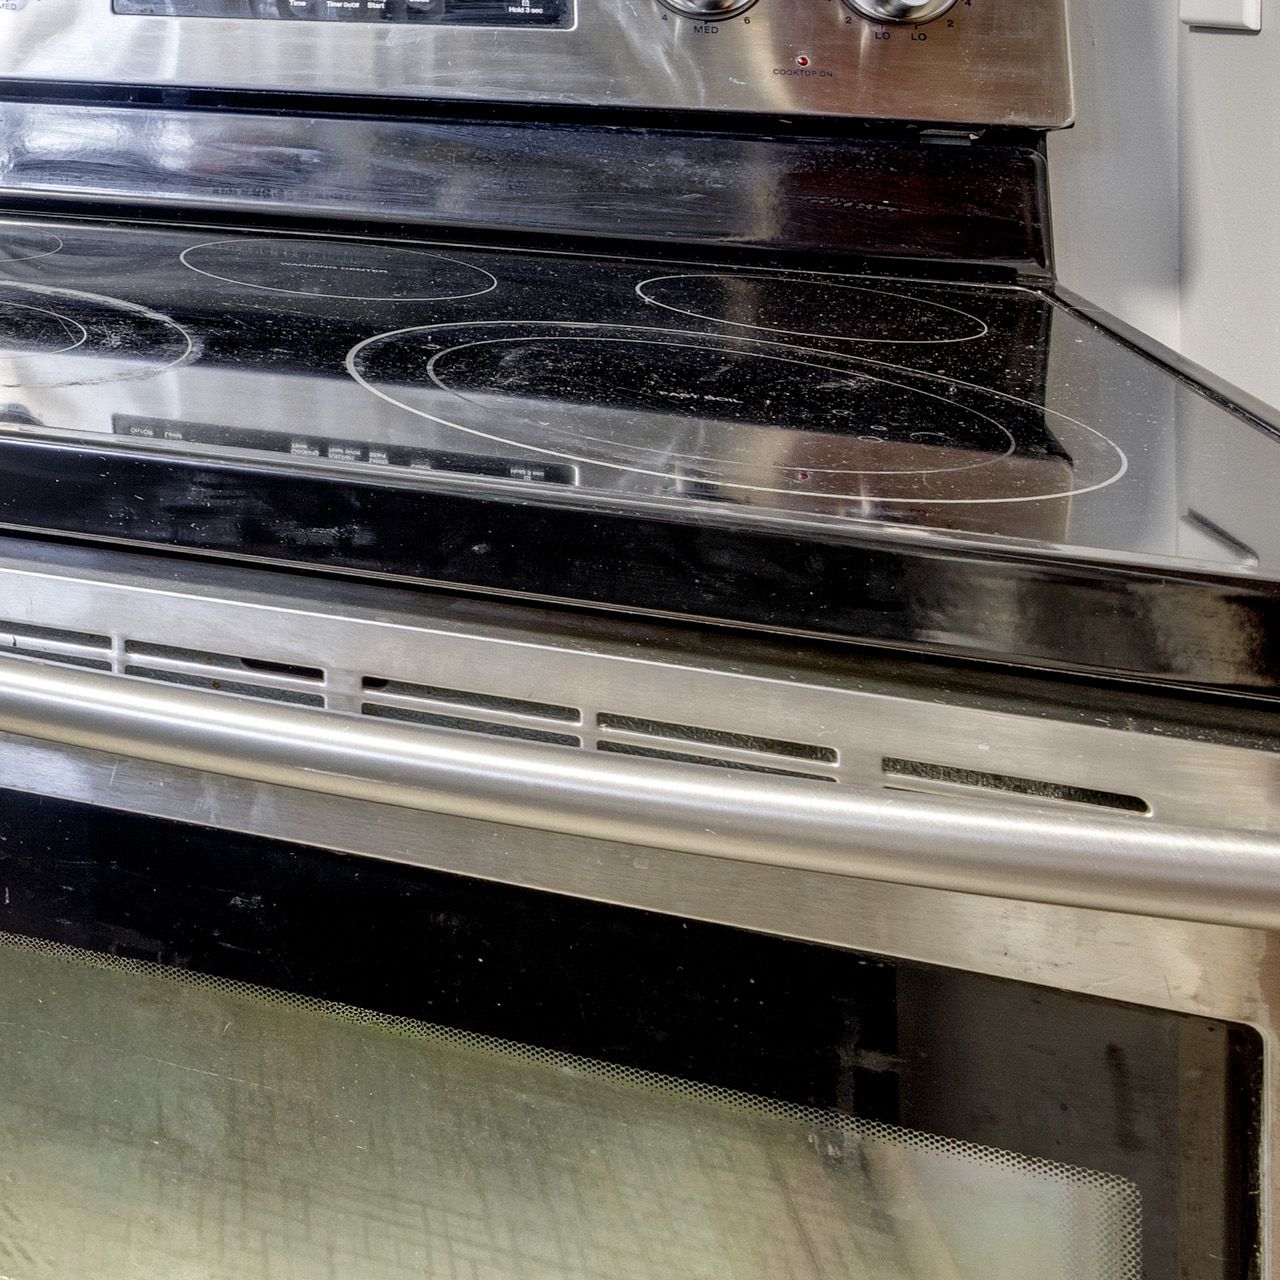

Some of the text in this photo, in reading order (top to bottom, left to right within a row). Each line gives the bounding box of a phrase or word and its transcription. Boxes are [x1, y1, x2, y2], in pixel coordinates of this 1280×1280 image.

[367, 1, 385, 9] Start
[508, 6, 524, 14] Hold
[693, 26, 719, 34] MED
[875, 32, 890, 40] LO
[911, 33, 927, 41] LO
[773, 68, 833, 78] COOKTOP ON
